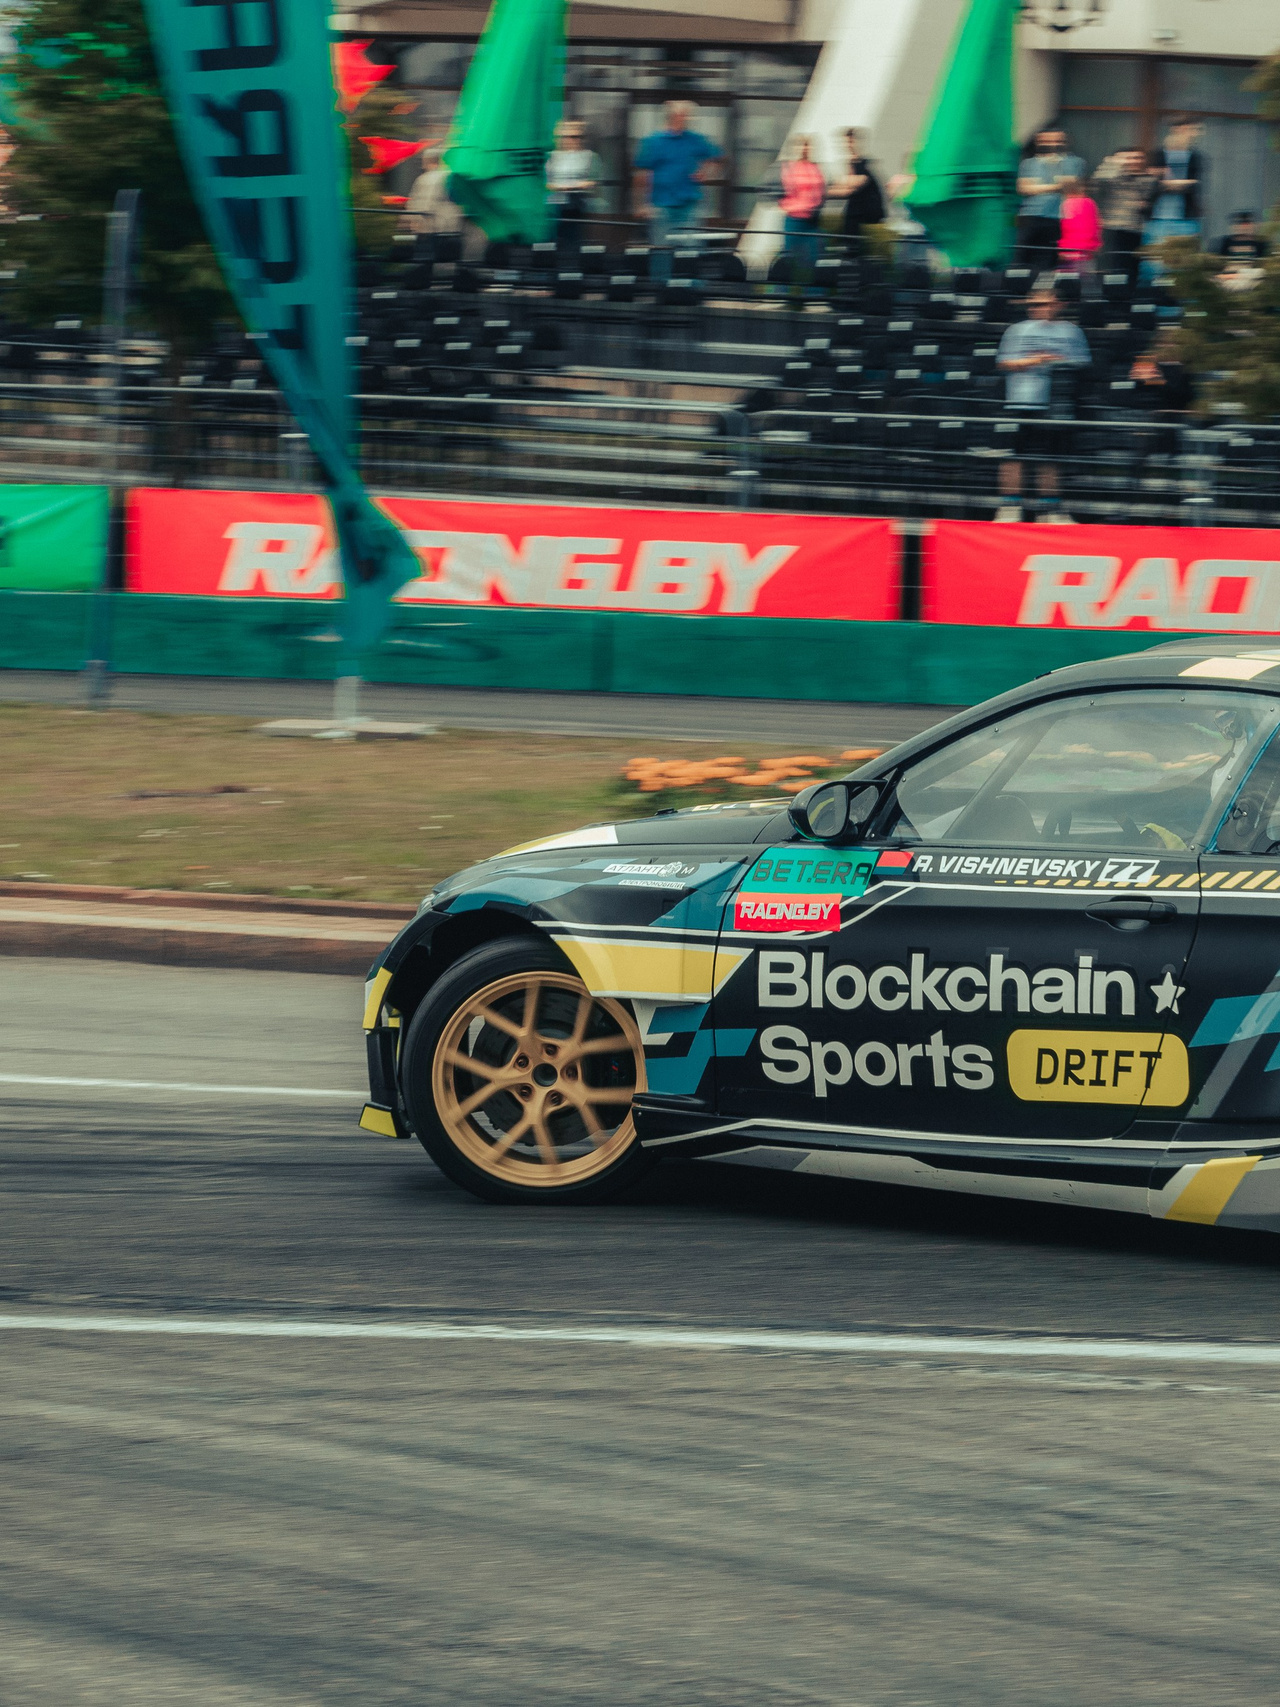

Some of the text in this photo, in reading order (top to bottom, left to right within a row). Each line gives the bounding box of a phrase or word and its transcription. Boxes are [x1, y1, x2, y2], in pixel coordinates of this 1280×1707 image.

[752, 859, 873, 885] BET.ERA
[939, 855, 1101, 878] VISHNEVSKY
[1103, 860, 1158, 881] 77
[740, 902, 834, 920] RACING.BY
[758, 950, 1136, 1016] Blockchain
[759, 1025, 1162, 1098] Sports DRIFT
